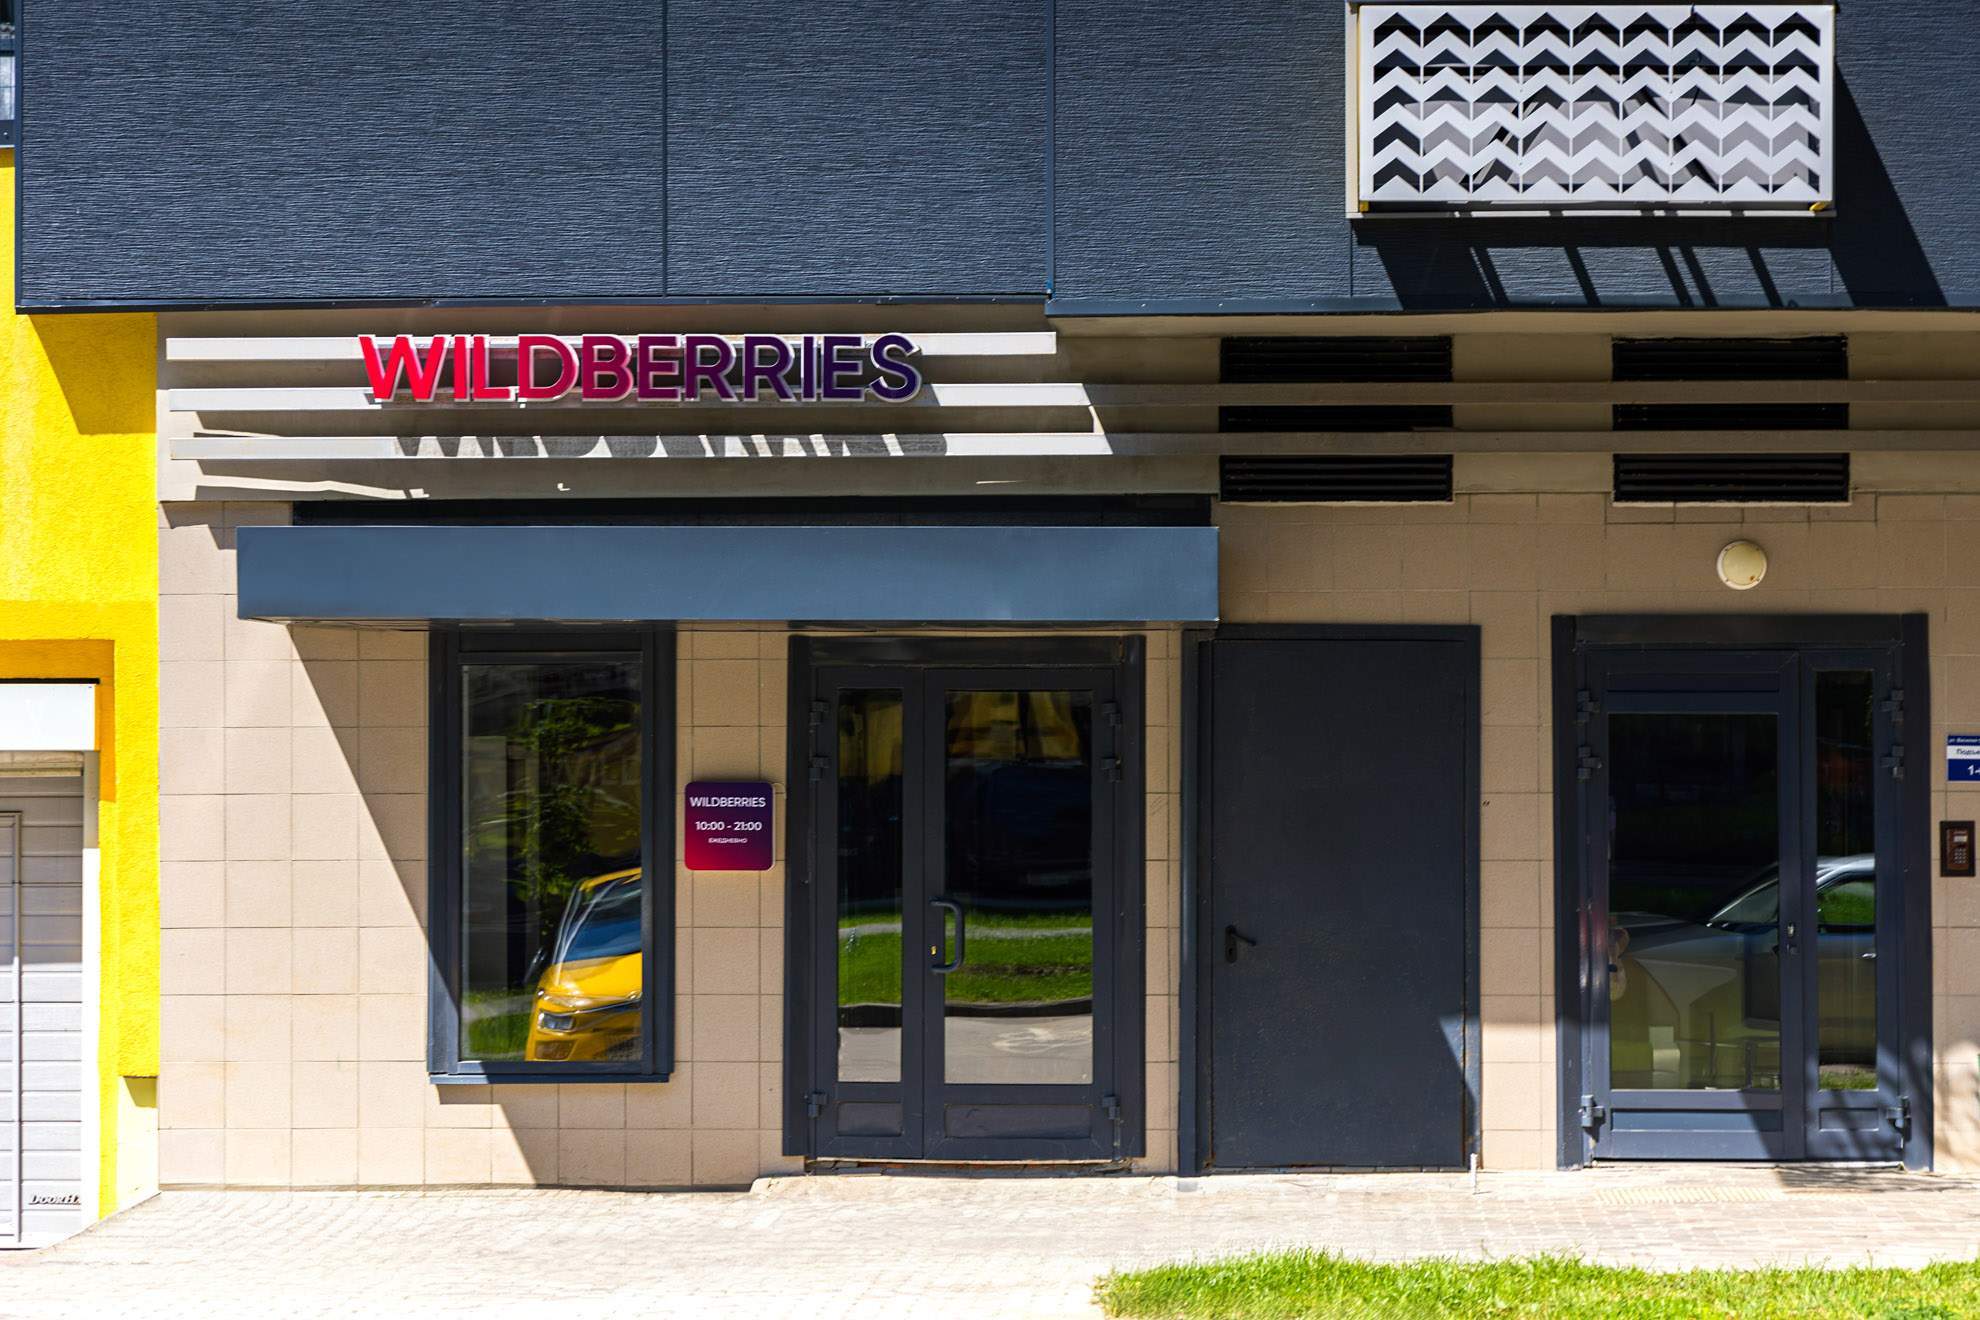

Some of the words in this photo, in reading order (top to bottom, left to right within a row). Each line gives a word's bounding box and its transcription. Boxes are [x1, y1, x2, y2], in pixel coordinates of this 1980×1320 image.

[359, 332, 923, 403] WILDBERRIES
[689, 797, 766, 807] WILDBERRIES
[695, 821, 725, 831] 10:00
[734, 821, 762, 831] 21:00
